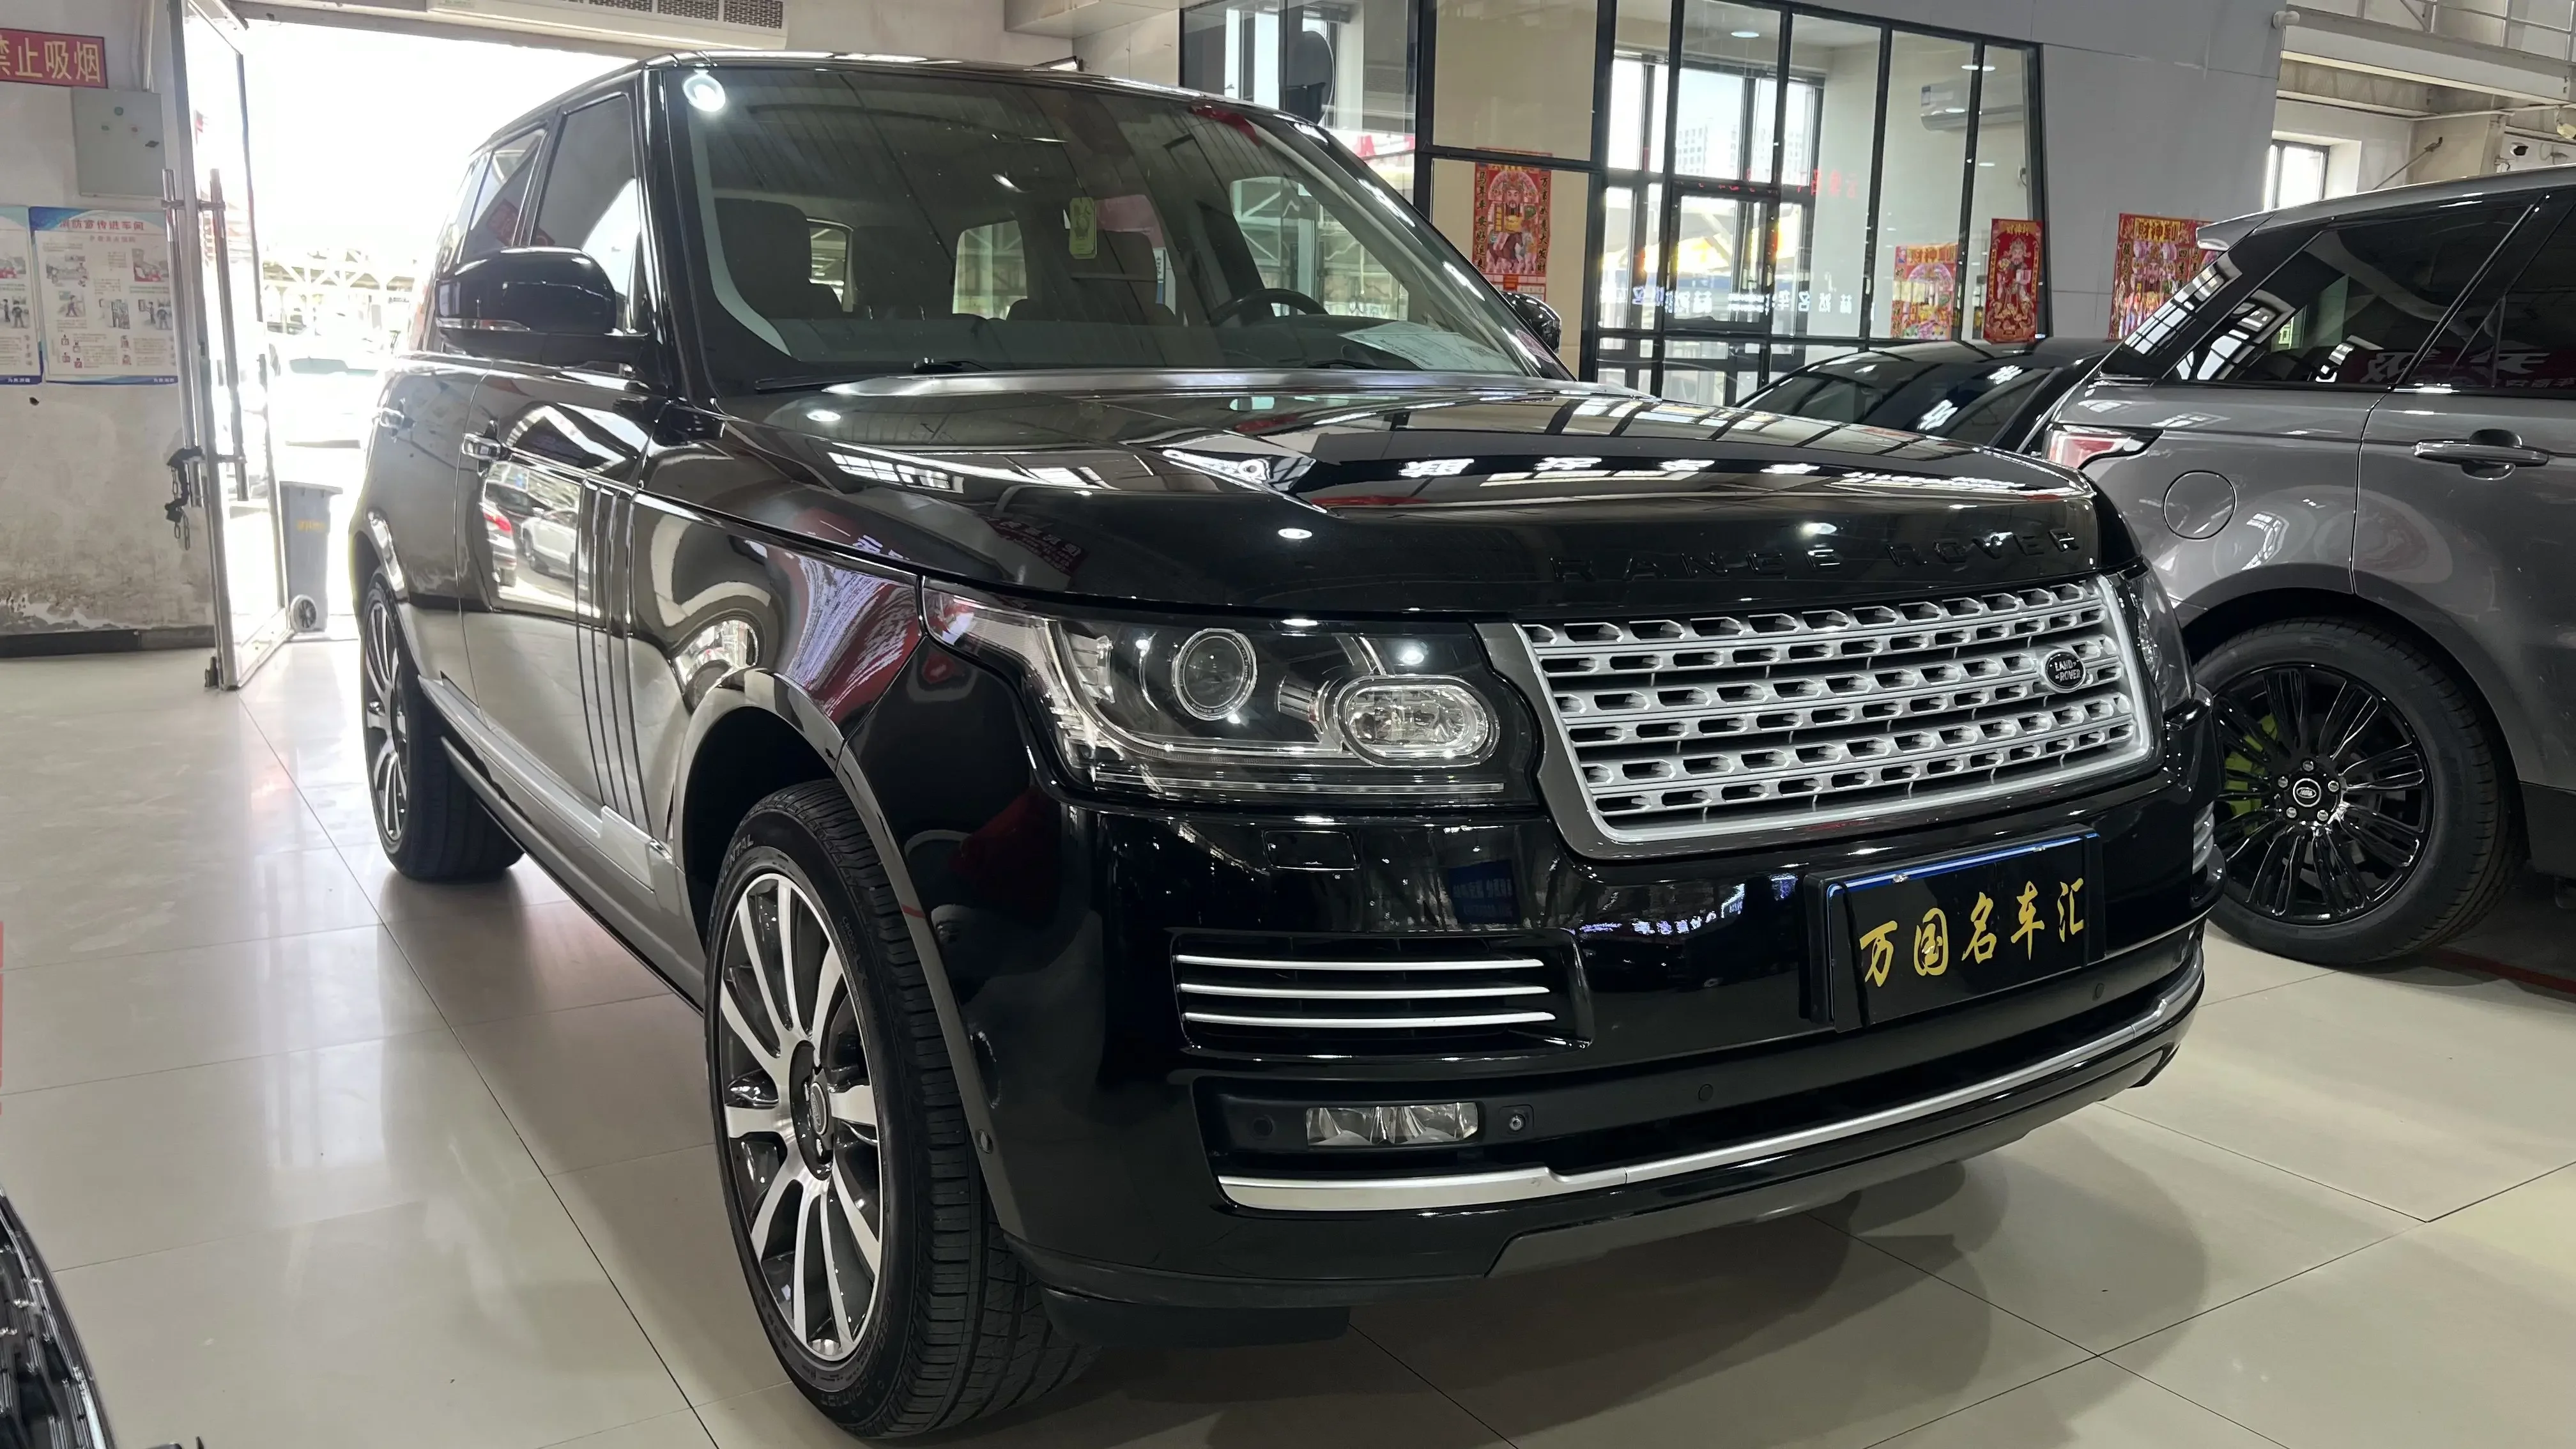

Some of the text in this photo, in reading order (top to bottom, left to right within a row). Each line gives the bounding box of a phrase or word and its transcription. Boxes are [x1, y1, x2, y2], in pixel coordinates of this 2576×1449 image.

[1549, 528, 2080, 583] RANGE ROVER
[2055, 659, 2073, 671] LAND
[2059, 669, 2081, 681] ROVER
[1859, 877, 2085, 988] 万国名车汇
